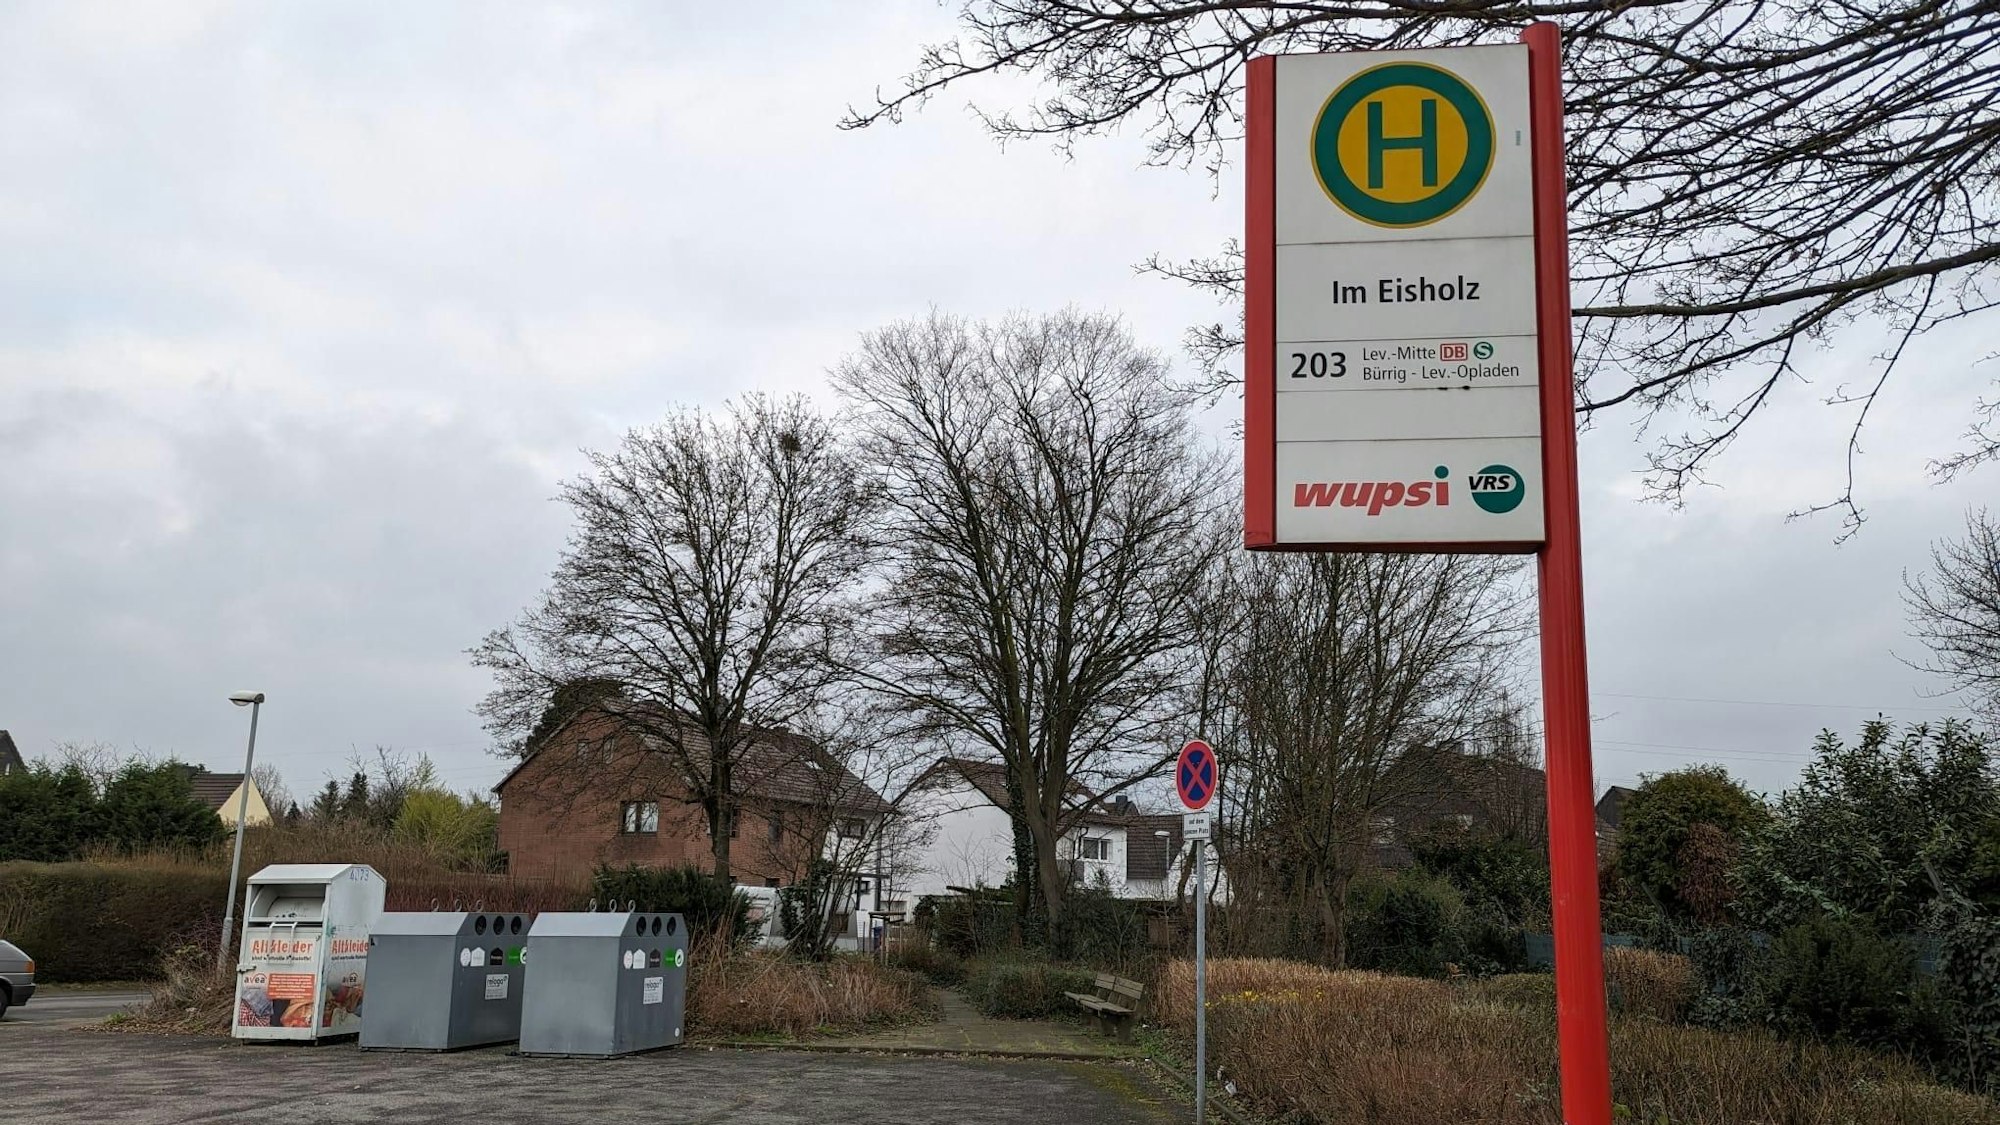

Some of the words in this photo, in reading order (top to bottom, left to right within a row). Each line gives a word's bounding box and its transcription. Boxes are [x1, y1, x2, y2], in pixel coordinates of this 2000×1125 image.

[1367, 98, 1438, 190] H
[1332, 280, 1367, 304] Im
[1378, 275, 1480, 303] Eisholz
[1362, 346, 1436, 361] Lev.-Mitte
[1442, 345, 1466, 360] DB
[1290, 352, 1347, 379] 203
[1362, 366, 1406, 383] Bürrig
[1421, 363, 1520, 380] Lev.-Opladen
[1293, 465, 1450, 516] wupsi
[1468, 475, 1511, 491] VRS
[332, 939, 369, 954] Altkleide
